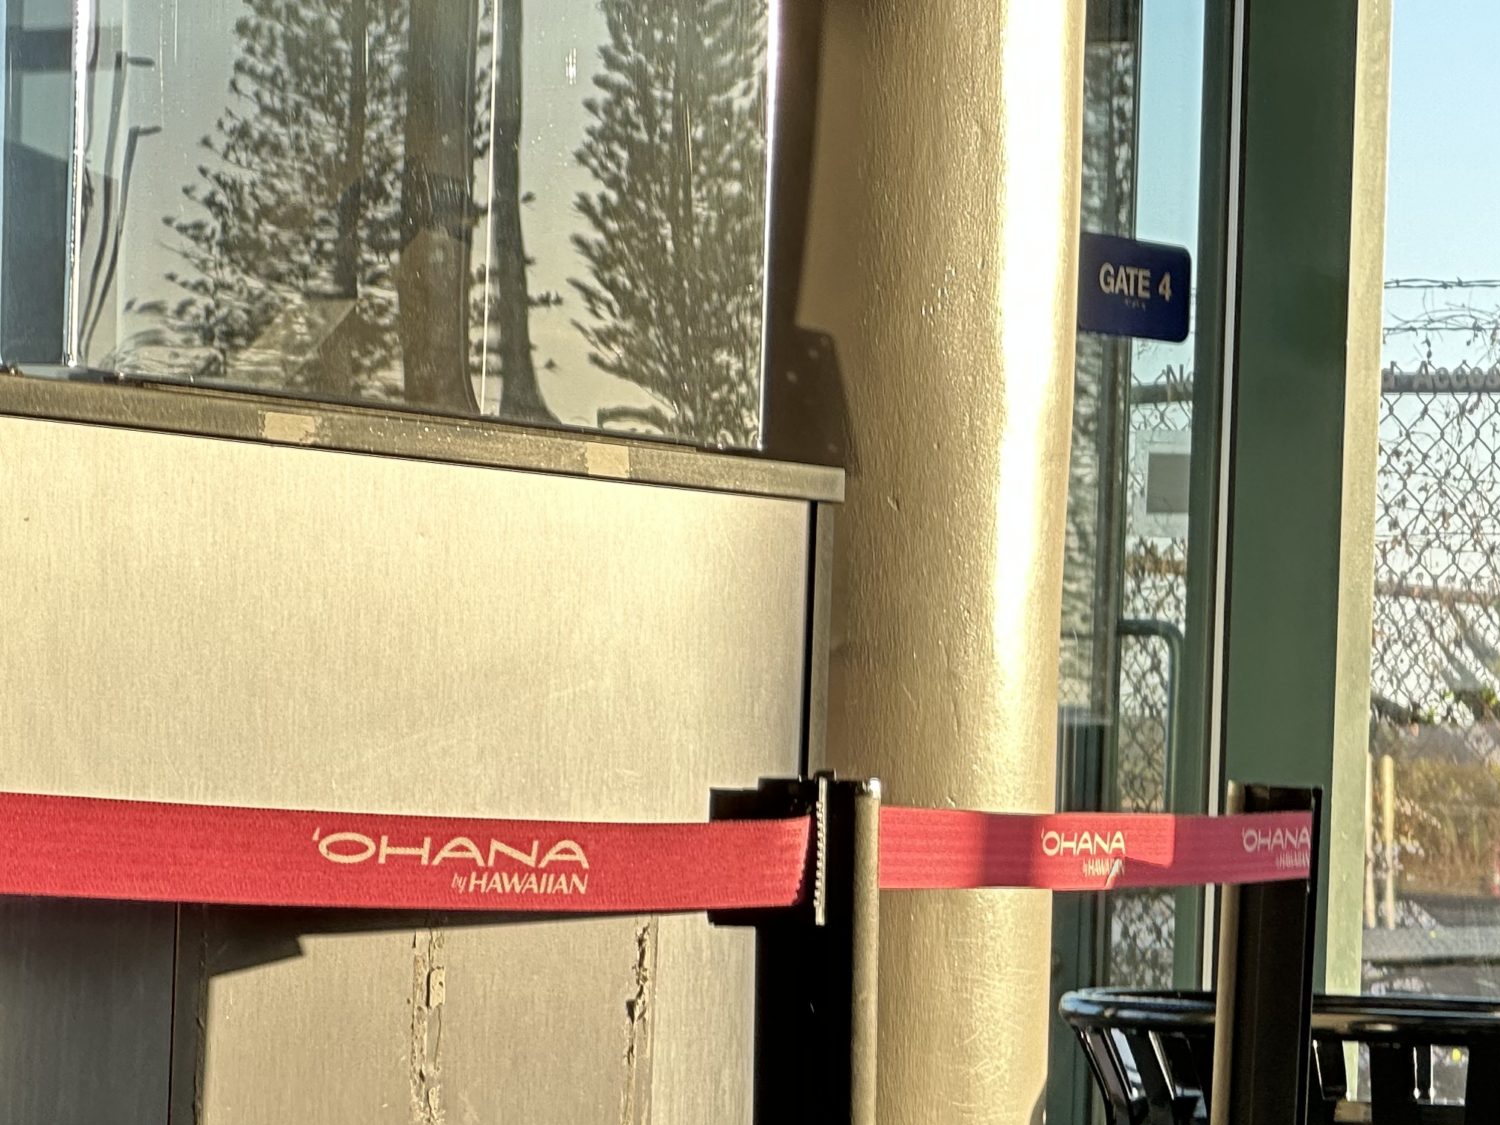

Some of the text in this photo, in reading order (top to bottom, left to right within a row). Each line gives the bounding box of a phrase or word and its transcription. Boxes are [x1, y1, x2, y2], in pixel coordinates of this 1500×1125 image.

[1098, 261, 1173, 303] GATE 4
[451, 871, 589, 895] by HAWAIIAN
